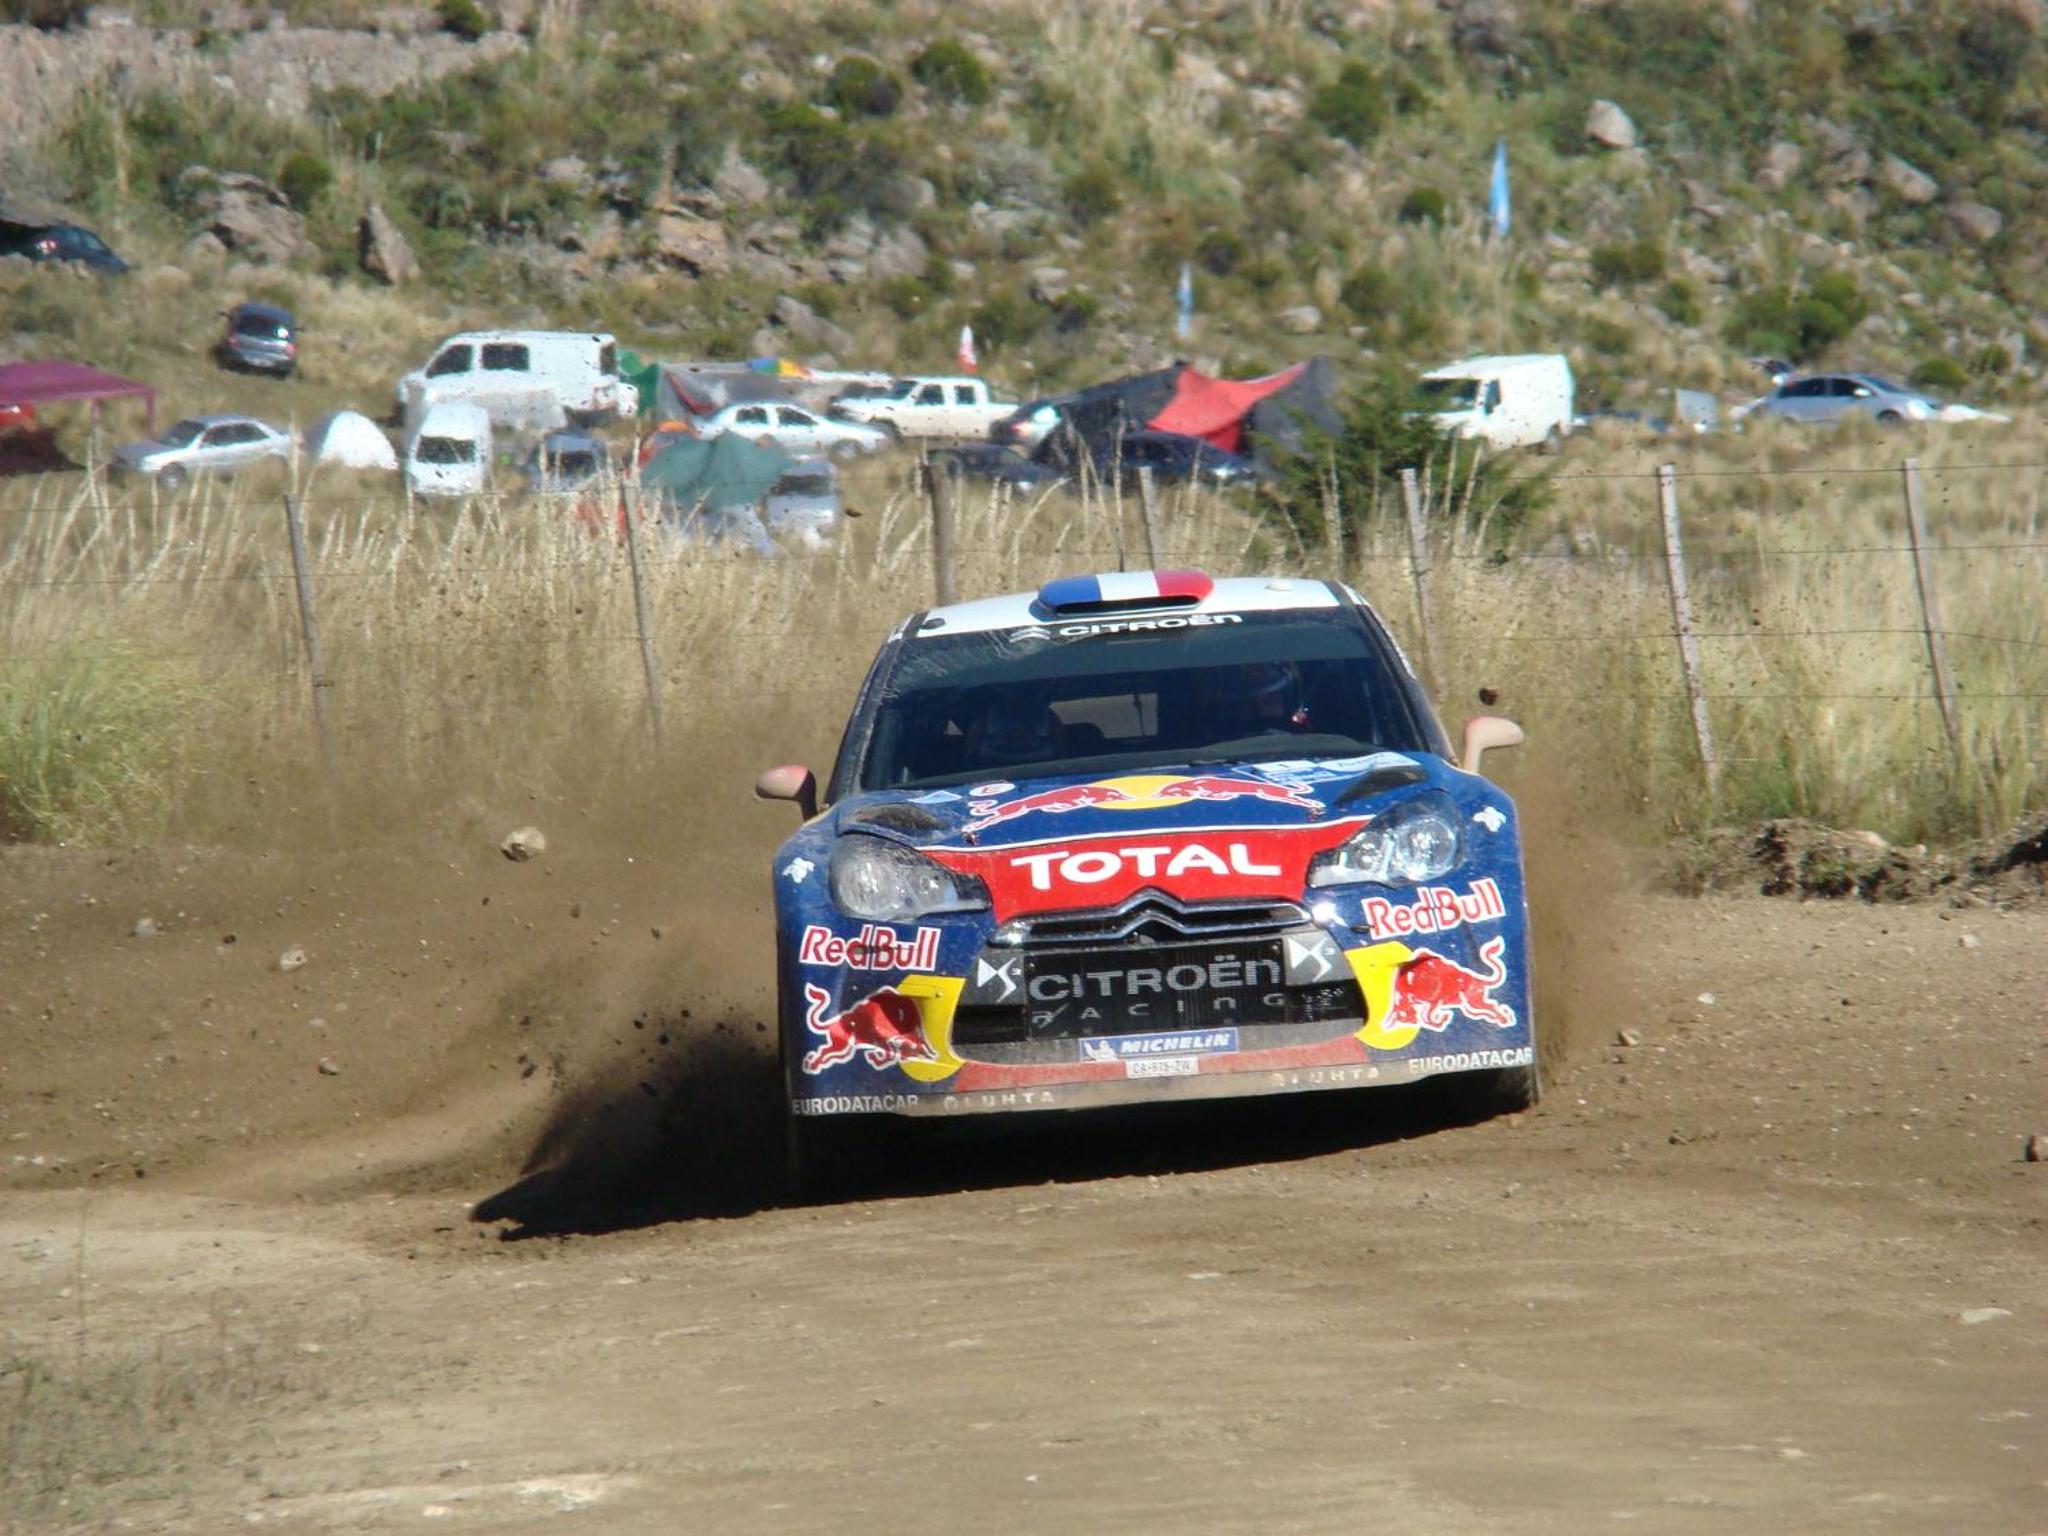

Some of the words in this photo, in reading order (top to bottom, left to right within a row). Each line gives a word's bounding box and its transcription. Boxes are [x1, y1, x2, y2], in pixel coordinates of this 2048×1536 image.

[1010, 844, 1281, 890] TOTAL
[1362, 887, 1436, 939] Red
[1433, 878, 1506, 932] Bull
[800, 925, 870, 970] Red
[871, 927, 941, 971] Bull
[1121, 1033, 1230, 1054] MICHELIN
[1408, 1046, 1534, 1074] EURODATACAR
[792, 1094, 919, 1115] EURODATACAR
